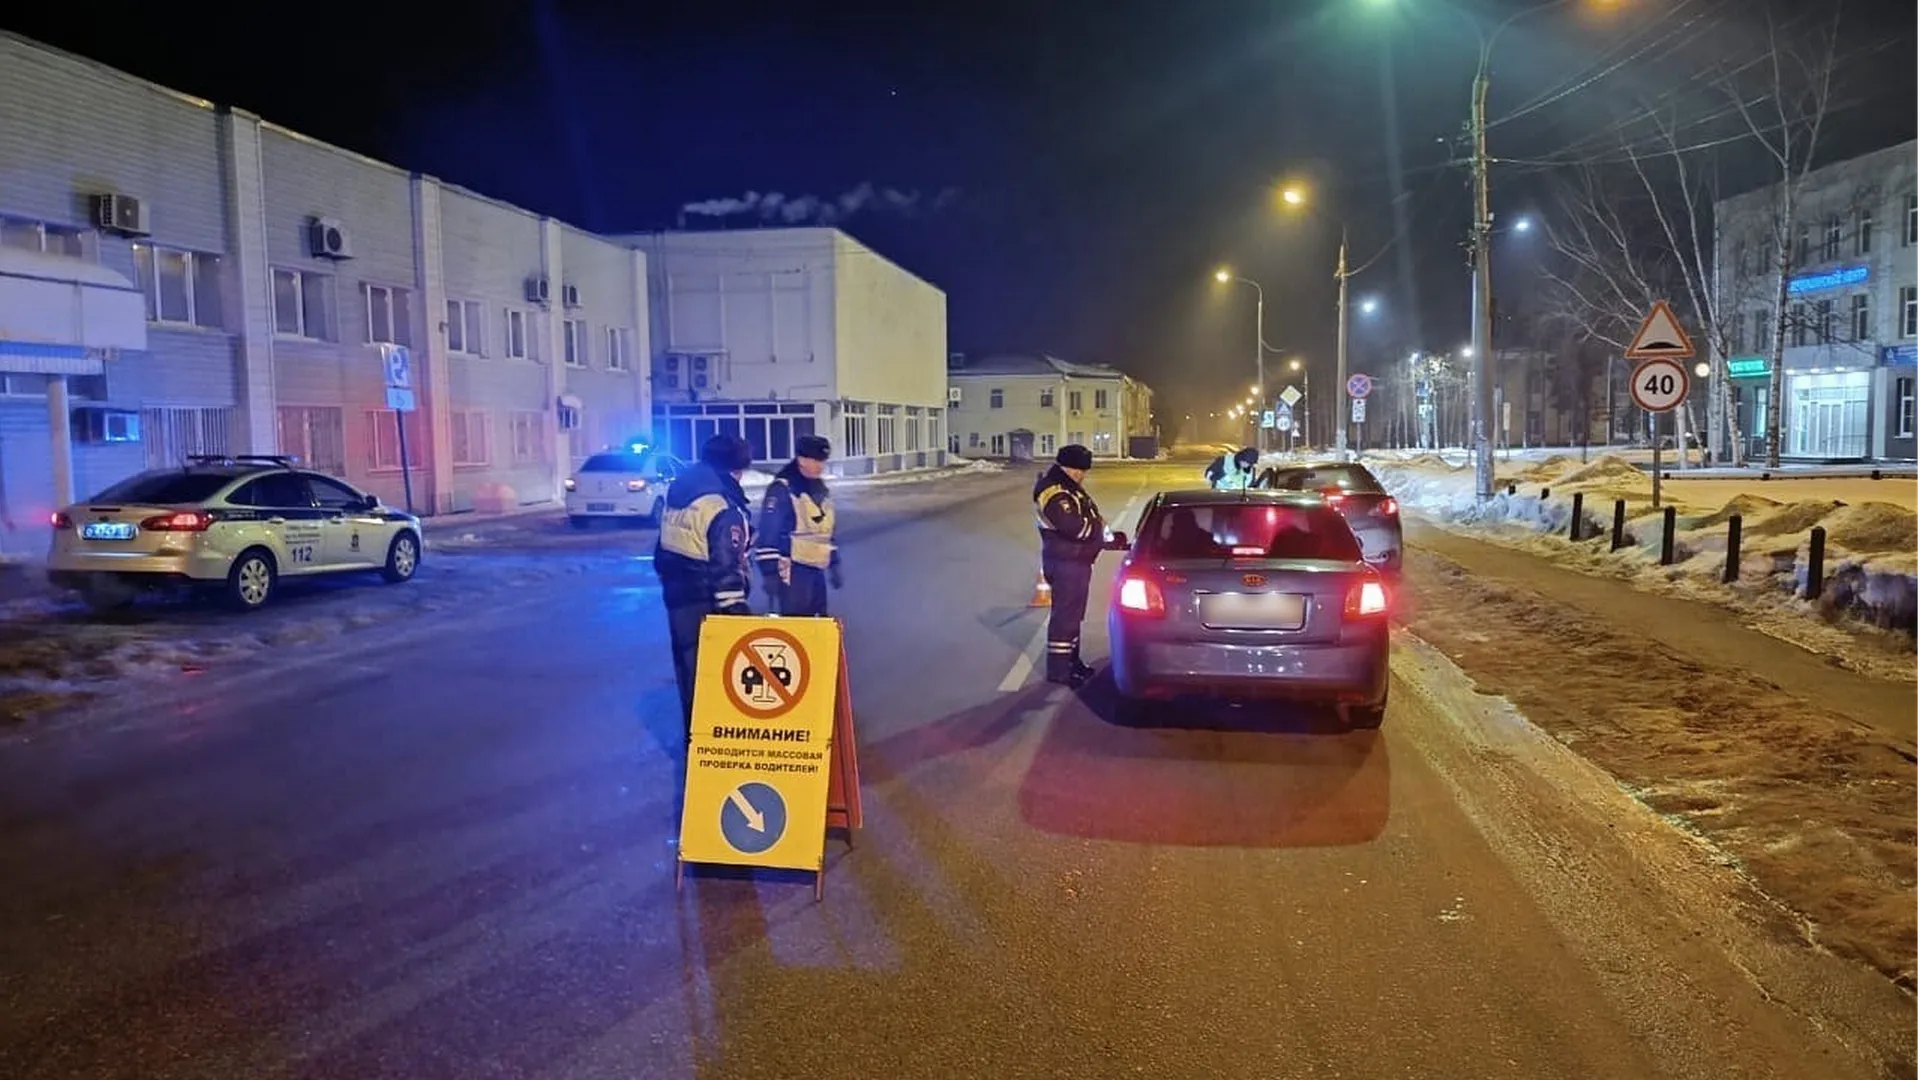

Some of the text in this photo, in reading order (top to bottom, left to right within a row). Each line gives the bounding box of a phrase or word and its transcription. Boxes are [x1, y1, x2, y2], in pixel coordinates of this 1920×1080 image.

[1644, 374, 1674, 395] 40
[292, 546, 312, 562] 112
[712, 726, 810, 742] ВНИМАНИЕ!
[696, 746, 823, 760] ПРОВОДИТСЯ МАССОВАЯ
[699, 759, 818, 774] ПРОВЕРКА ВОДИТЕЛЕЙ!
